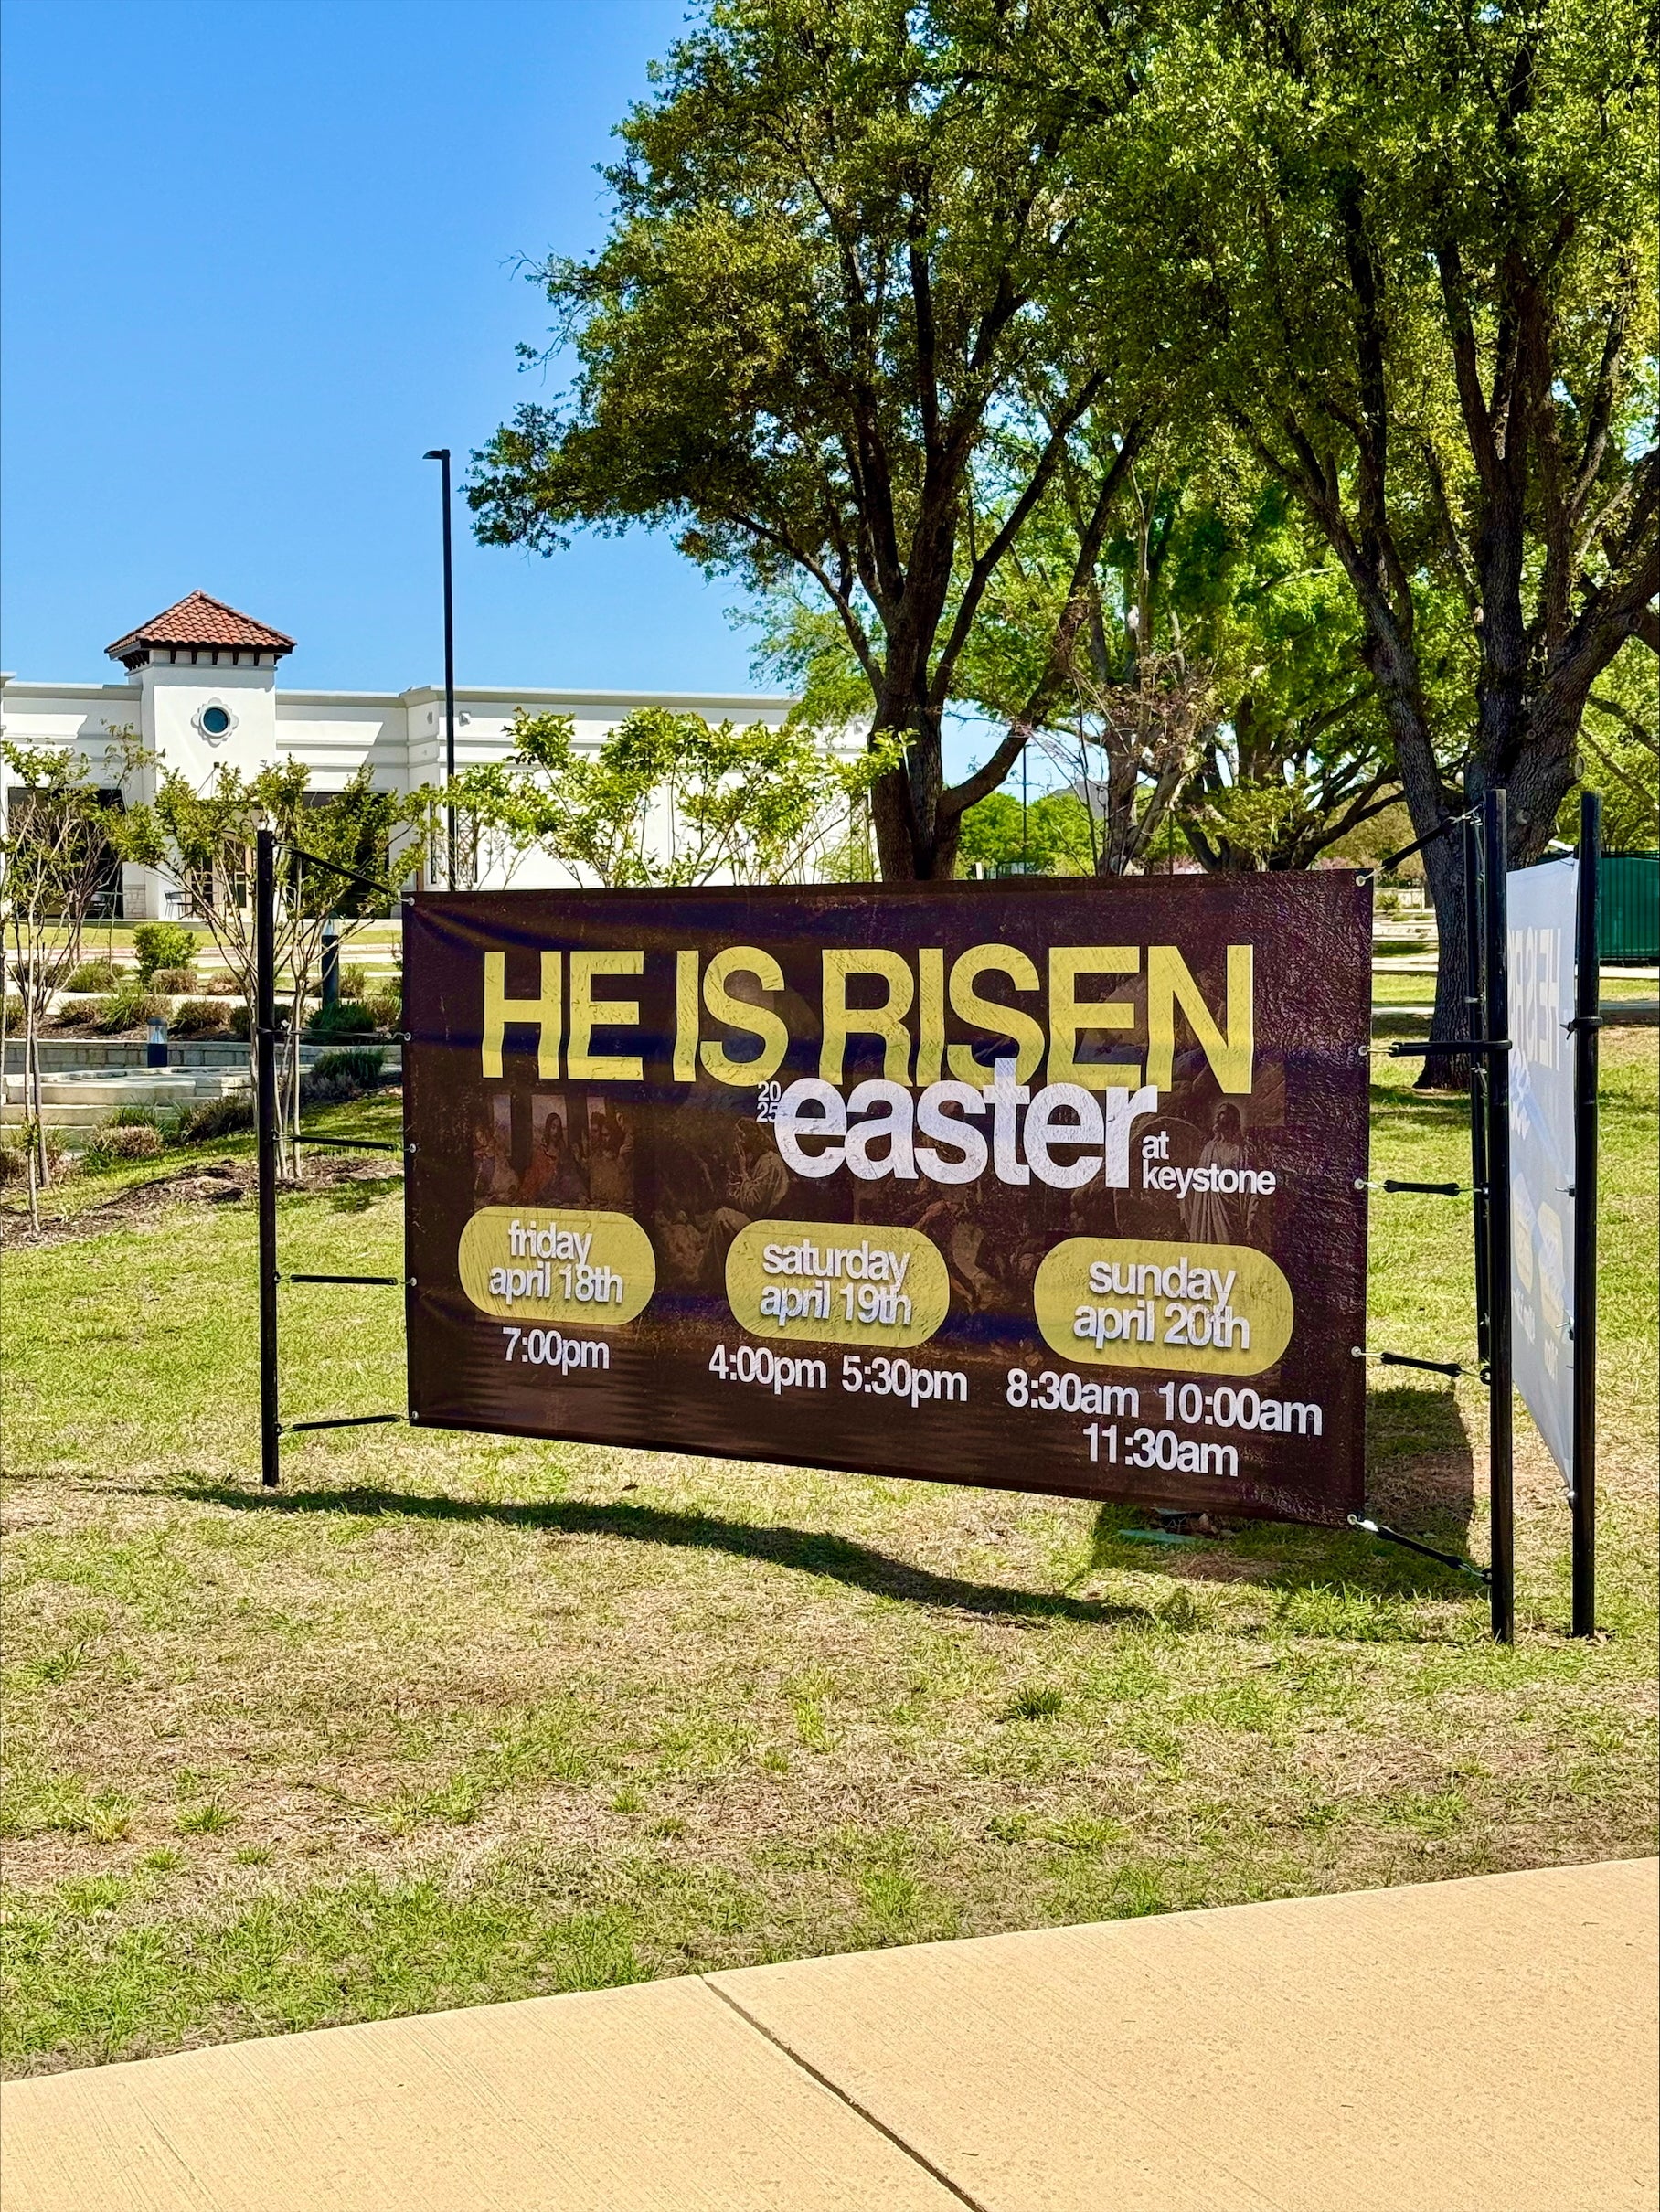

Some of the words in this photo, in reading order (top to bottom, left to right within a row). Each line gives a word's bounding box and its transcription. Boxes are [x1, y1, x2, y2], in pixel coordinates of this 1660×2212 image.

[482, 950, 644, 1080] HE
[673, 946, 789, 1087] IS
[818, 943, 1254, 1094] RISEN
[756, 1101, 777, 1123] 25
[757, 1080, 782, 1102] 20
[773, 1058, 1158, 1190] easter
[1142, 1130, 1170, 1160] at
[1142, 1159, 1276, 1199] keystone
[508, 1219, 592, 1266] friday
[762, 1239, 910, 1292] saturday
[489, 1261, 550, 1305] april
[559, 1263, 623, 1303] 18th
[760, 1280, 830, 1326] april
[840, 1281, 912, 1325] 19th
[1088, 1256, 1236, 1312] sunday
[1073, 1300, 1155, 1350] april
[1163, 1303, 1250, 1350] 20th
[503, 1326, 610, 1376] 7:00pm
[708, 1344, 827, 1395] 4:00pm
[841, 1354, 968, 1408] 5:30pm
[1006, 1367, 1140, 1418] 8:30am
[1158, 1381, 1323, 1436] 10:00am
[1082, 1422, 1239, 1477] 11:30am
